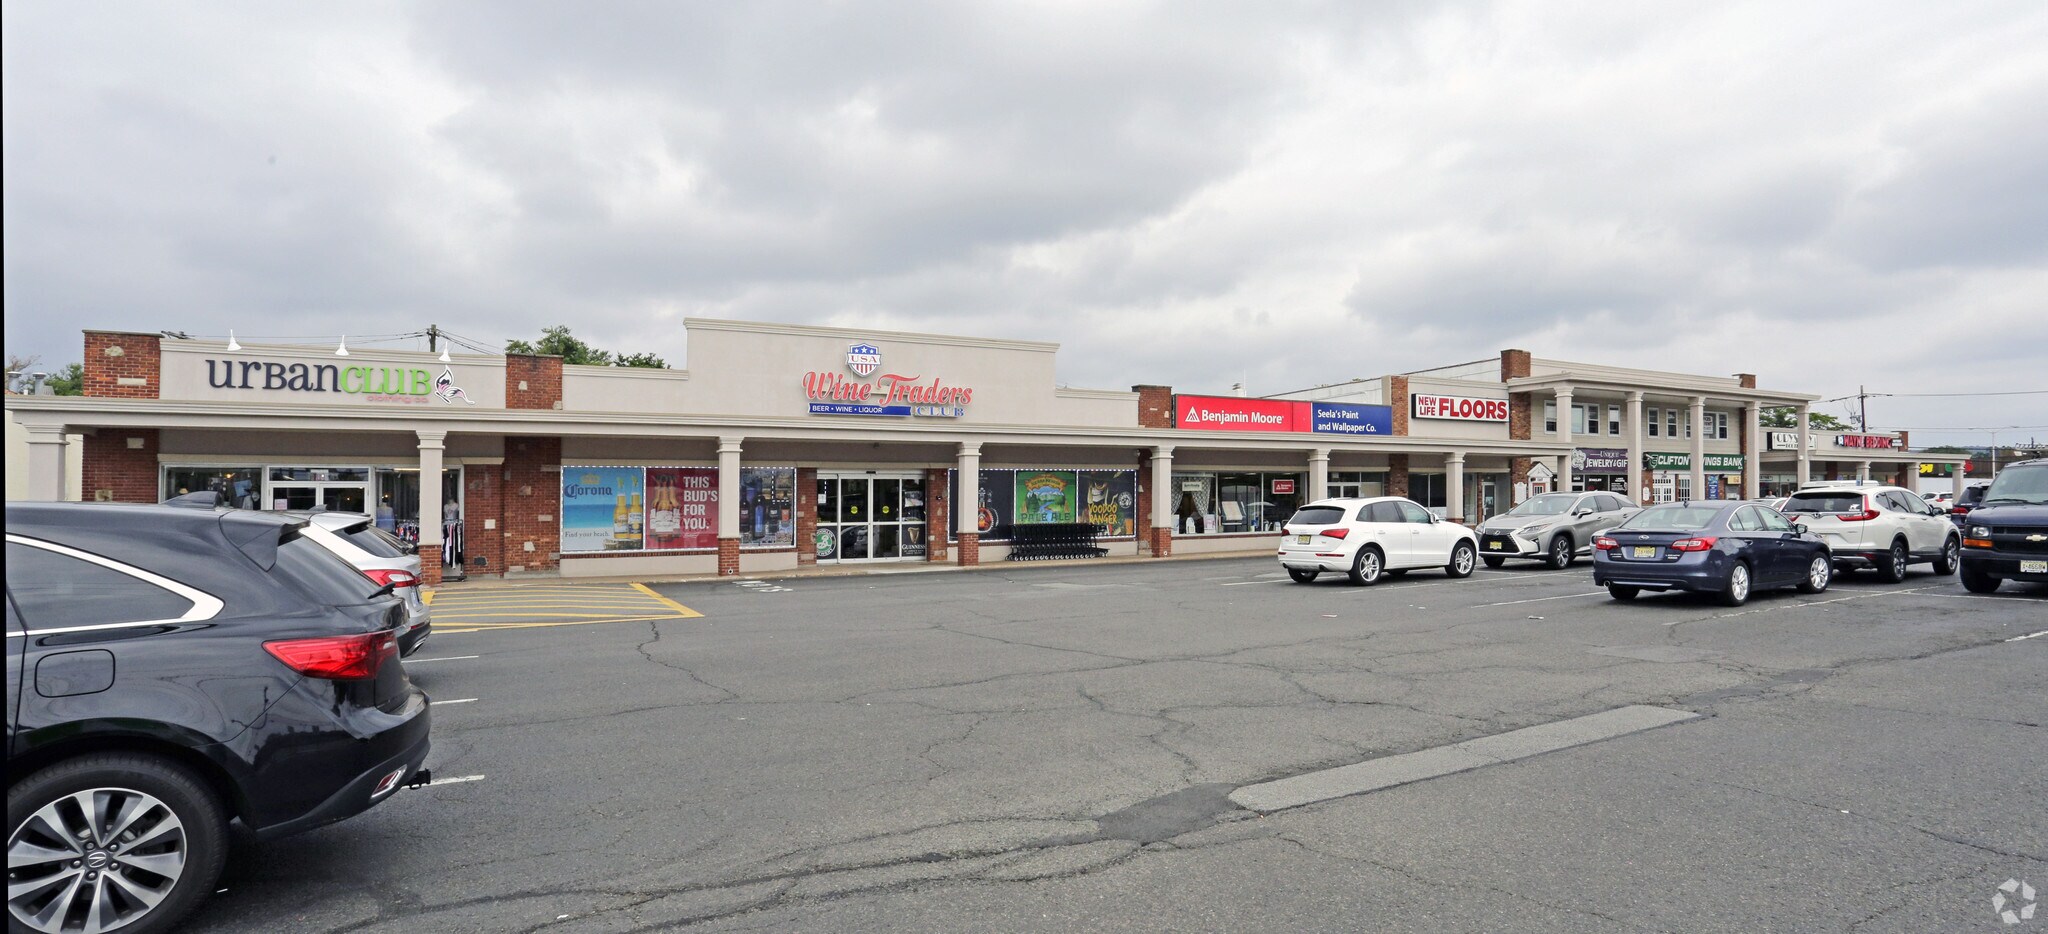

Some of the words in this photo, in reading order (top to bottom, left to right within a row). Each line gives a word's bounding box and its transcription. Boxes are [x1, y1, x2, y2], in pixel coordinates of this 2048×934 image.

[851, 356, 877, 364] USA
[802, 371, 872, 401] Wine
[877, 374, 973, 406] Traders
[1419, 397, 1436, 406] NEW
[917, 406, 964, 417] CLUB
[1420, 406, 1435, 416] LIFE
[1439, 398, 1507, 419] FLOORS
[1201, 410, 1248, 425] Benjamin
[1251, 411, 1283, 424] Moore
[1318, 410, 1341, 419] Seela's
[1342, 411, 1359, 419] Paint
[1318, 423, 1331, 431] and
[1332, 423, 1365, 433] Wallpaper
[1366, 424, 1376, 432] Co.
[1844, 434, 1865, 447] WAYNE
[1865, 435, 1891, 448] BEDDING
[1617, 459, 1628, 468] GIF
[1658, 455, 1689, 465] CLIFTON
[1723, 457, 1743, 466] BANK
[683, 477, 709, 488] THIS
[564, 484, 613, 499] Corona
[684, 490, 718, 502] BUD'S
[684, 504, 705, 516] FOR
[1088, 504, 1117, 514] VOODOO
[1021, 512, 1047, 522] PALE
[1051, 512, 1070, 521] ALE
[1089, 514, 1117, 524] RANGER
[684, 518, 709, 530] YOU.
